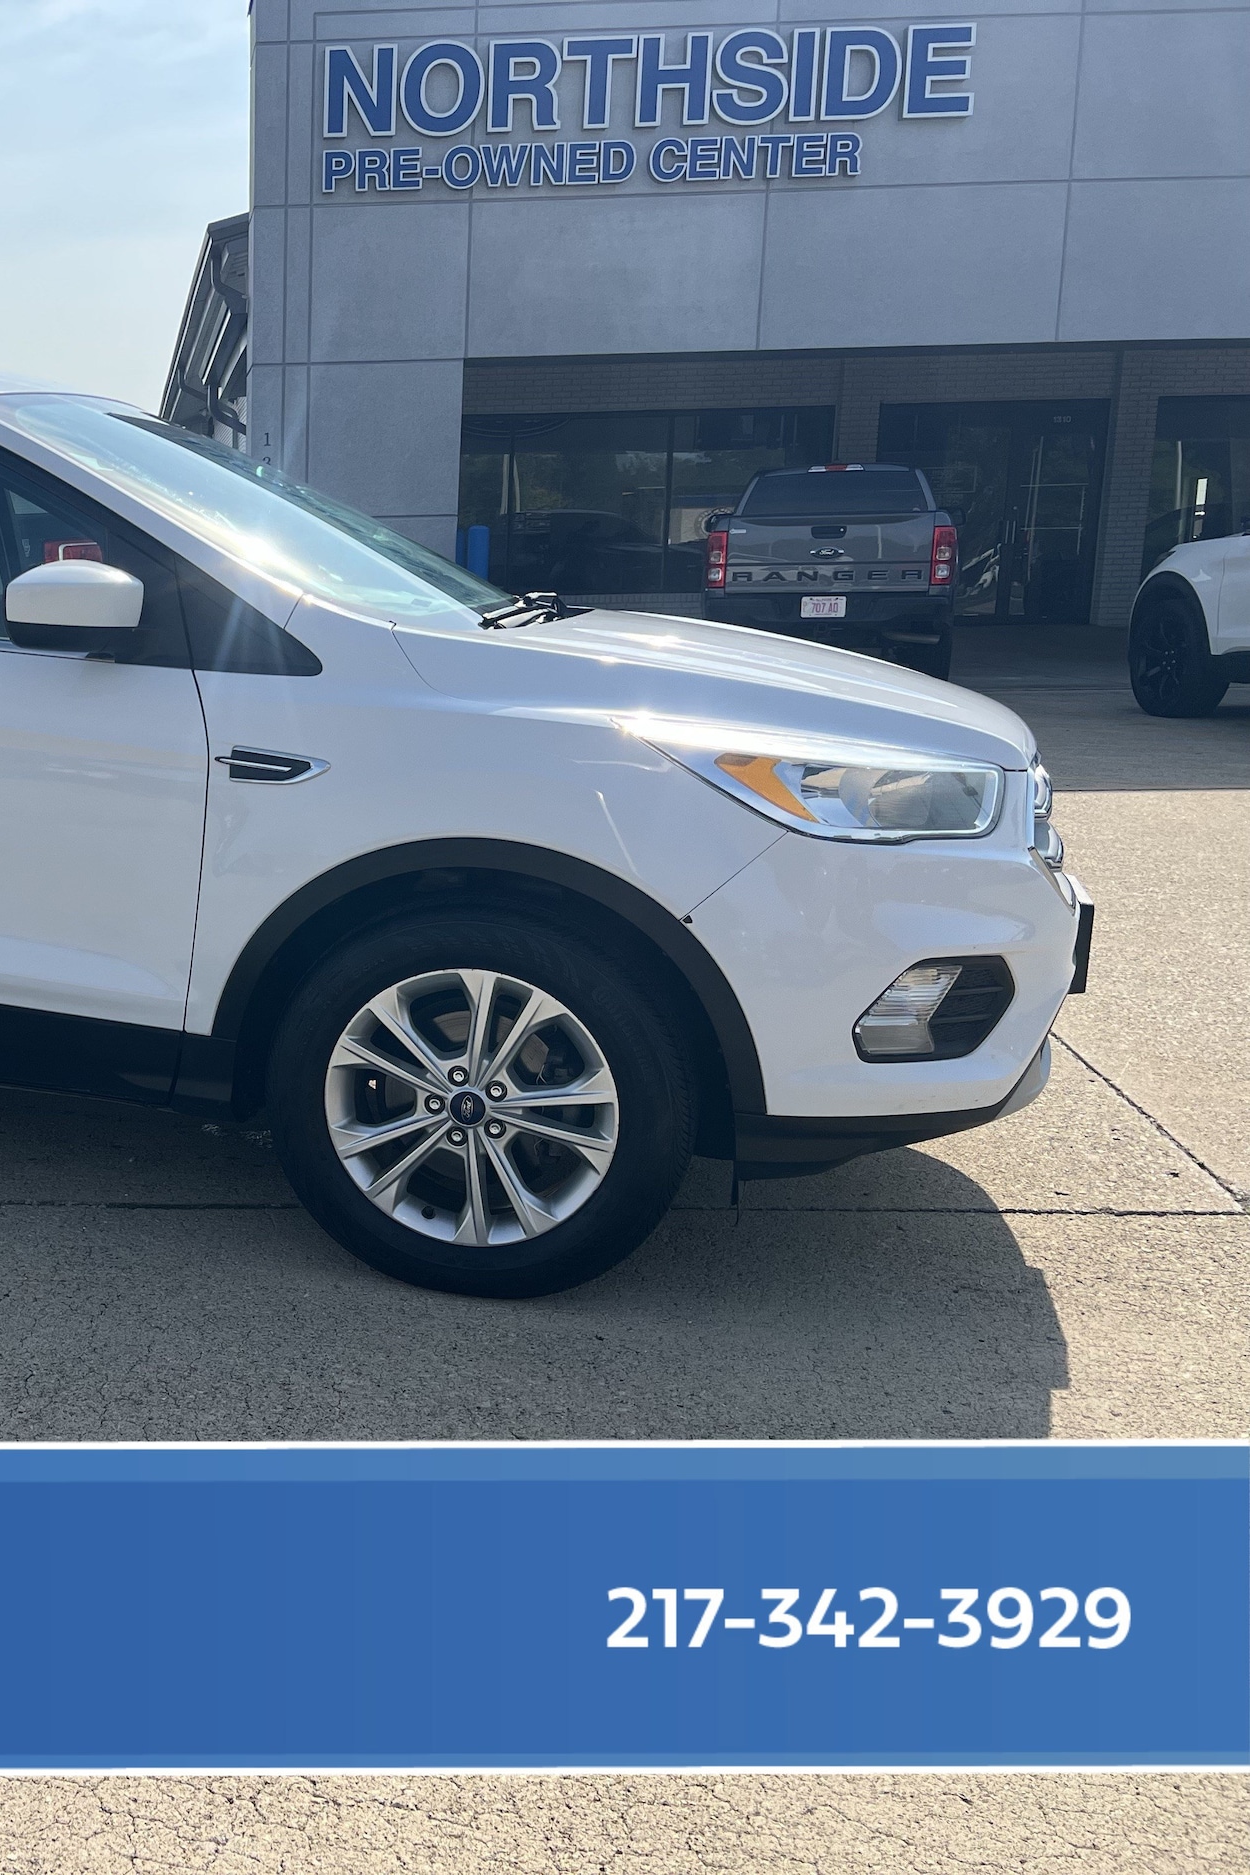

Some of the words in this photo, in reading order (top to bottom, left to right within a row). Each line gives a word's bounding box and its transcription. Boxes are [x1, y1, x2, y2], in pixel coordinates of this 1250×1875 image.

[323, 23, 977, 139] NORTHSIDE
[323, 140, 636, 193] PRE-OWNED
[650, 132, 861, 183] CENTER
[732, 569, 924, 582] RANGER
[811, 602, 826, 613] 707
